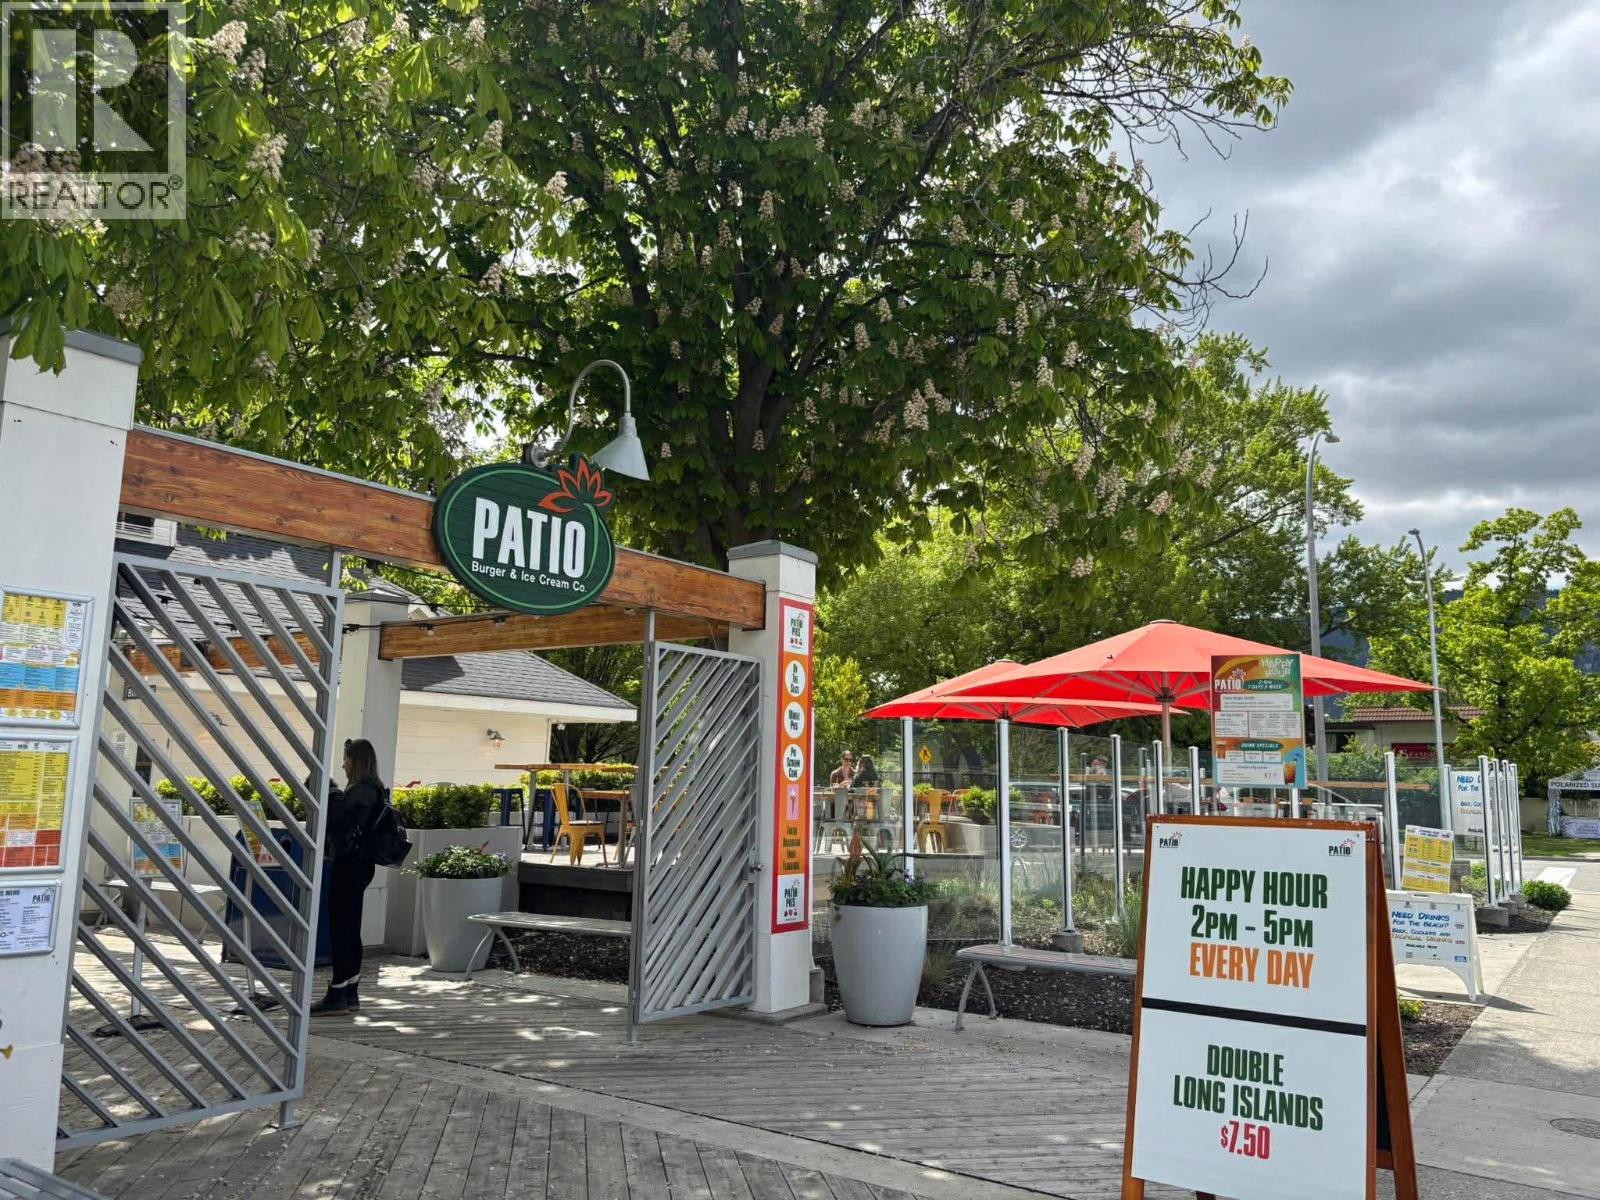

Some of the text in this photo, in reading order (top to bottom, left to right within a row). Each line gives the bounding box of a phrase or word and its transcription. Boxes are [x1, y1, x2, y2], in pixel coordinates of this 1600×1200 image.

[472, 496, 586, 579] PATIO
[471, 560, 587, 593] Burger & Ice Cream Co.
[1214, 679, 1242, 691] PATIO
[1159, 837, 1179, 846] PATIO
[1328, 845, 1351, 855] PATIO
[1180, 866, 1328, 909] HAPPY HOUR
[1190, 904, 1238, 941] 2PM
[1263, 909, 1314, 948] 5PM
[1391, 911, 1450, 922] NEED DRINKS
[1189, 942, 1314, 988] EVERY DAY
[1206, 1044, 1285, 1087] DOUBLE
[1172, 1074, 1324, 1131] LONG ISLANDS
[1220, 1120, 1271, 1160] $7.50
